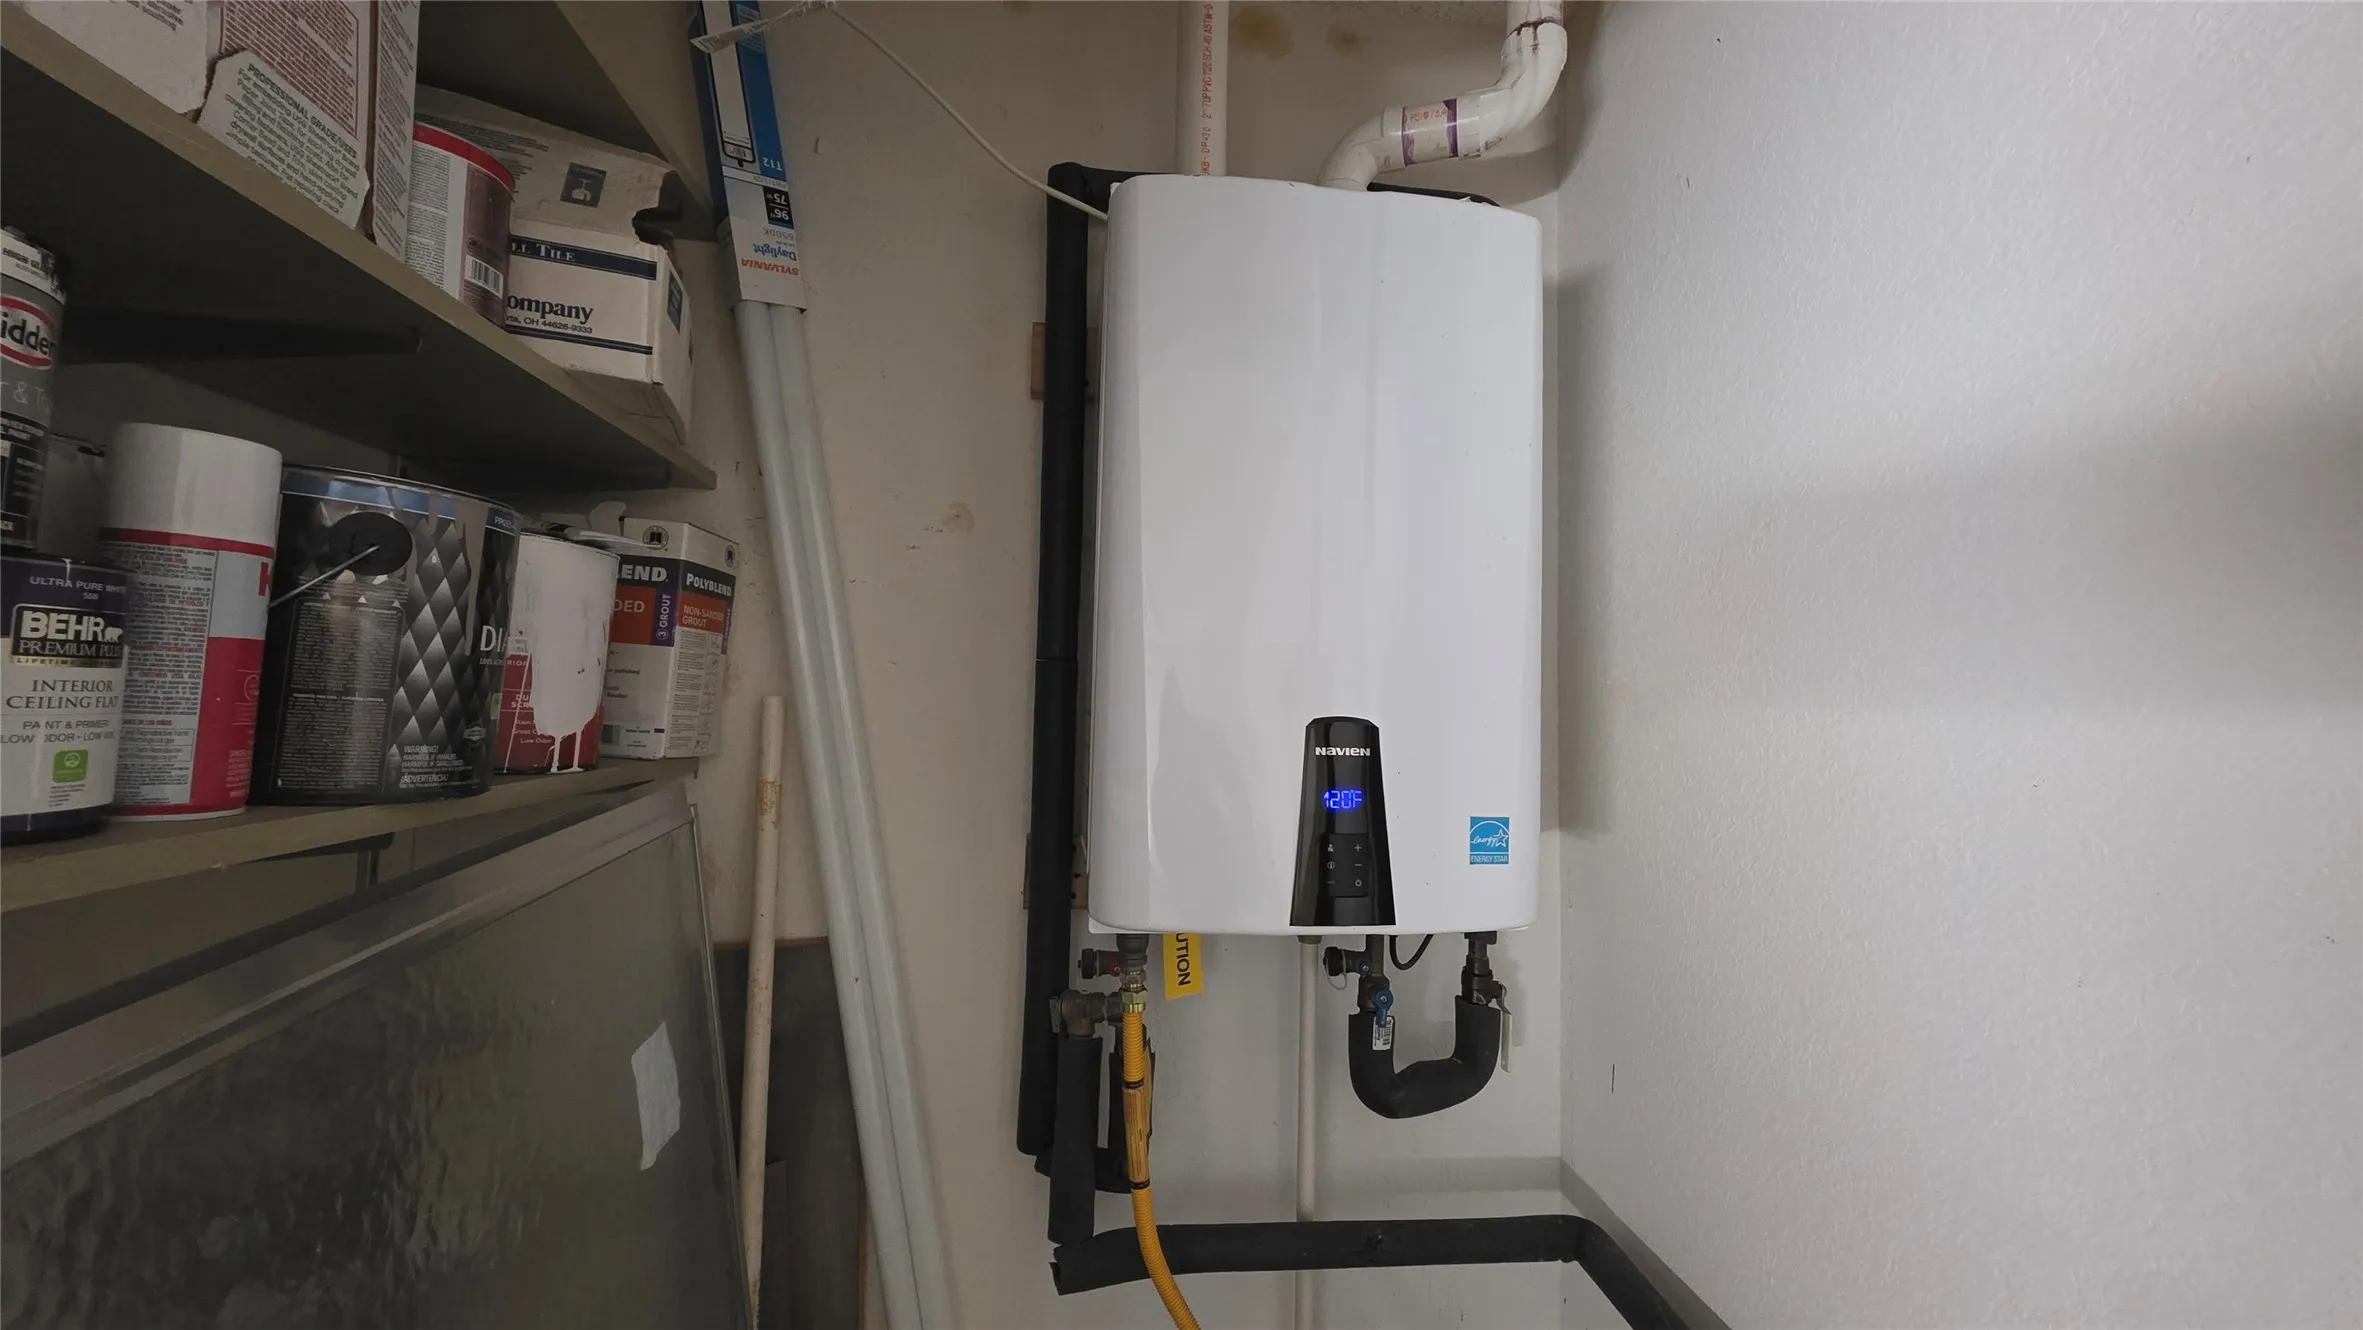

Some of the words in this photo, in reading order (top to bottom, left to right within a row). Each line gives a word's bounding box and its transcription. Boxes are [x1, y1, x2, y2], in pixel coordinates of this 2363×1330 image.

[238, 68, 250, 82] For
[248, 63, 310, 119] PROFESSIONAL
[310, 115, 357, 158] GRADE/USES
[763, 157, 783, 171] T12
[763, 226, 794, 240] 6500K
[753, 243, 797, 261] Daylight
[741, 258, 799, 276] SYLVANIA
[507, 295, 594, 325] ompany
[523, 317, 539, 326] OH
[29, 576, 73, 588] ULTRA
[76, 580, 104, 592] PURE
[686, 572, 732, 597] POLYBLEND
[659, 594, 671, 628] GROUT
[21, 611, 106, 642] BEHR
[682, 615, 707, 629] GROUT
[19, 640, 97, 657] PREMIUM
[32, 679, 113, 693] INTERIOR
[6, 695, 92, 710] CEILING
[95, 696, 118, 709] FLAT
[23, 720, 62, 730] PANT
[65, 721, 72, 730] &
[76, 719, 109, 729] PRIMER
[1, 734, 36, 744] LOW
[1470, 855, 1492, 863] ENERGY
[1493, 855, 1508, 863] STAR
